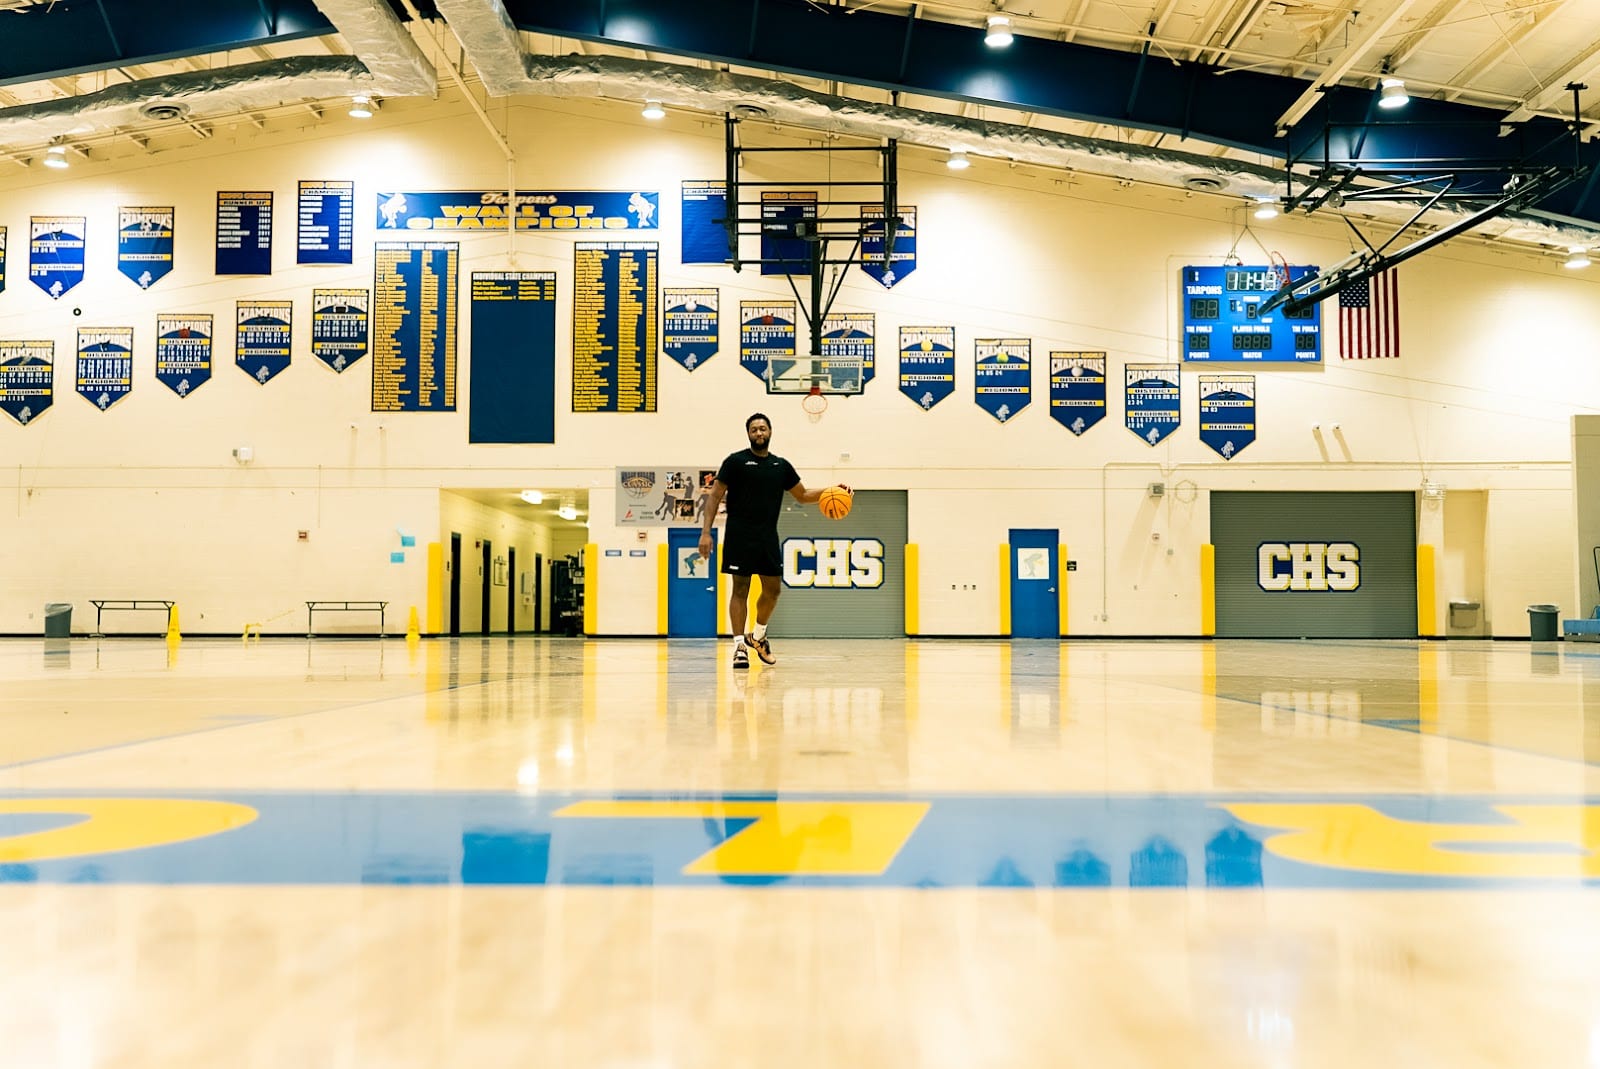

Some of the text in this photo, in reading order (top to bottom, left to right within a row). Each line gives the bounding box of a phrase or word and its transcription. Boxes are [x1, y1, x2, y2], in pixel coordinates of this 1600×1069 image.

[440, 206, 594, 218] WALL OF
[406, 217, 629, 230] CHAMPIONS
[1186, 286, 1222, 294] TARPONS
[1052, 359, 1105, 376] CHAMPIONS
[1127, 371, 1179, 388] CHAMPIONS
[1201, 383, 1255, 400] CHAMPIONS
[623, 479, 653, 488] CLASSIC
[783, 538, 884, 589] CHS
[1257, 542, 1361, 592] CHS
